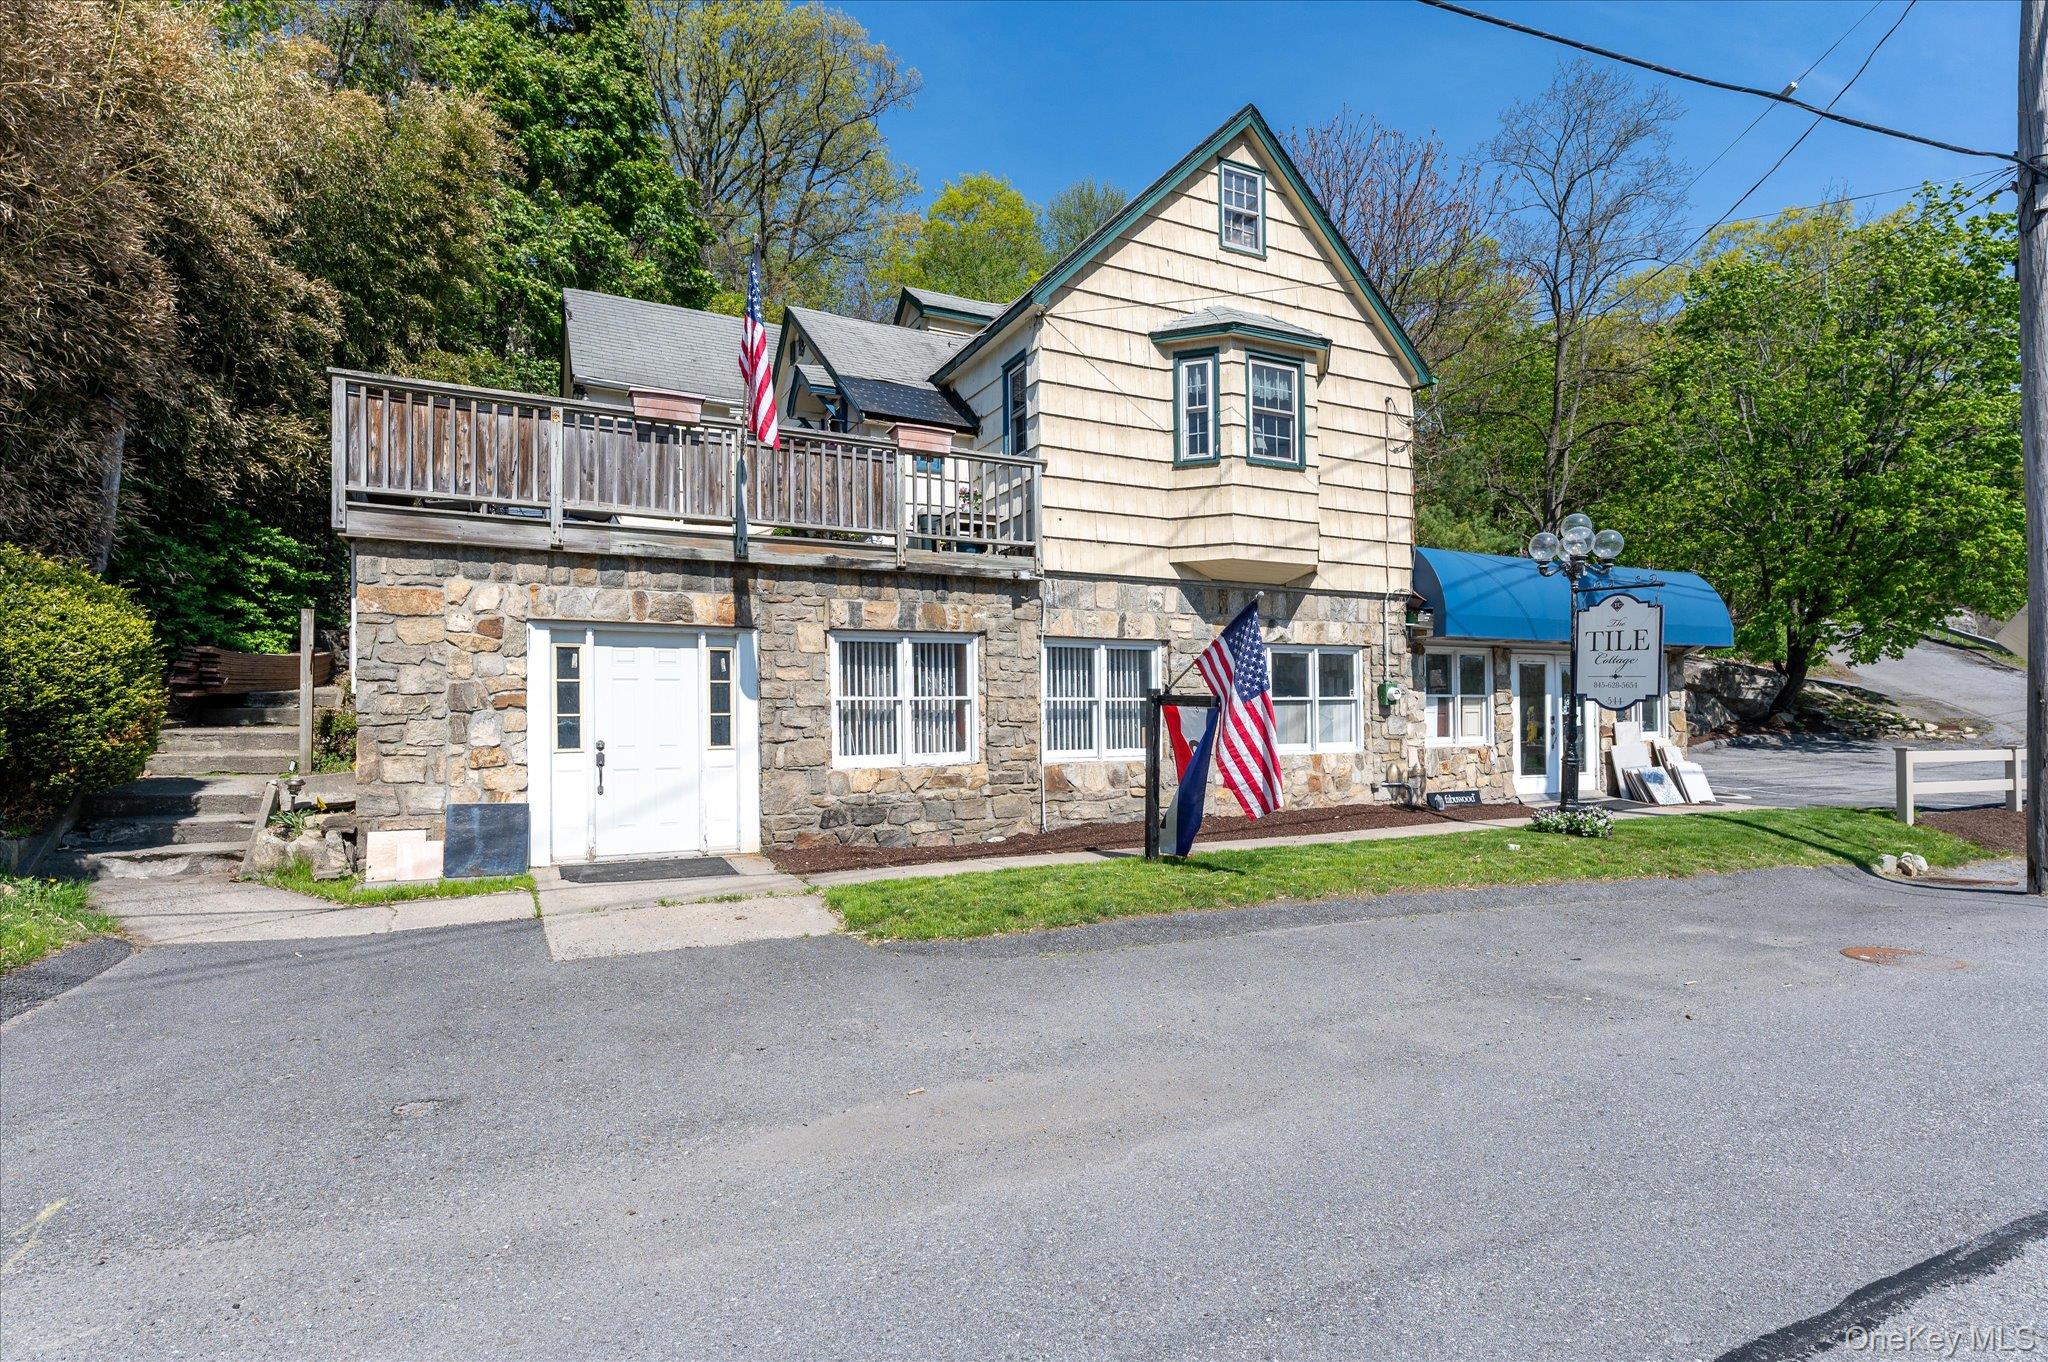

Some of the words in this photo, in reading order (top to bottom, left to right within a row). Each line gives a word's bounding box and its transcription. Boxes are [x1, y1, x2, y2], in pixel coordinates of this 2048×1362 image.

[1607, 616, 1628, 627] The
[1585, 629, 1650, 652] TILE
[1594, 652, 1638, 674] Cottage
